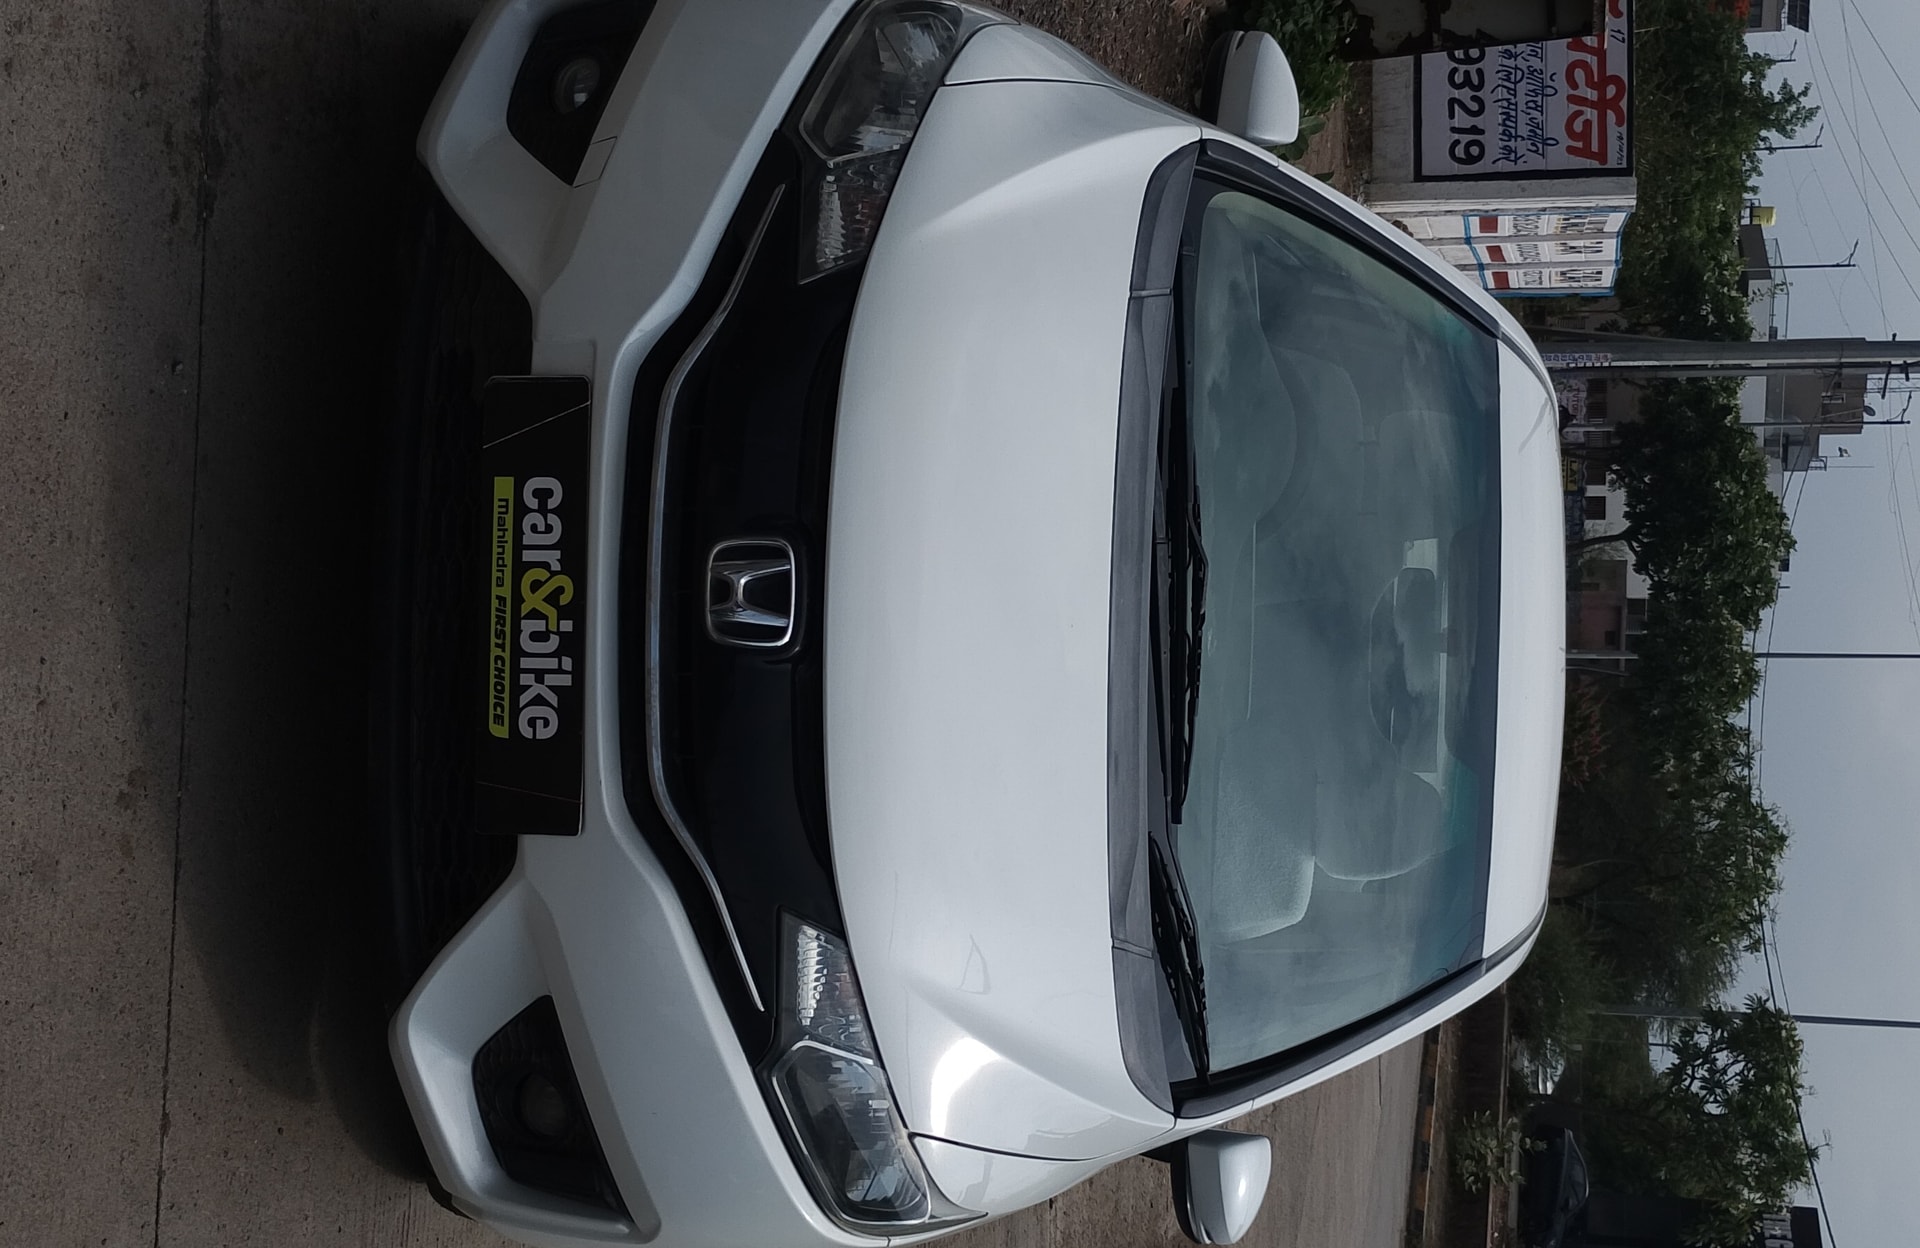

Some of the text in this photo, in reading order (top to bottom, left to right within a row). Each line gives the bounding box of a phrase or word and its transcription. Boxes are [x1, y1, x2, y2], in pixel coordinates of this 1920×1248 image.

[494, 594, 507, 653] FIRST
[518, 476, 574, 740] car&bike
[492, 654, 506, 728] CHOICE
